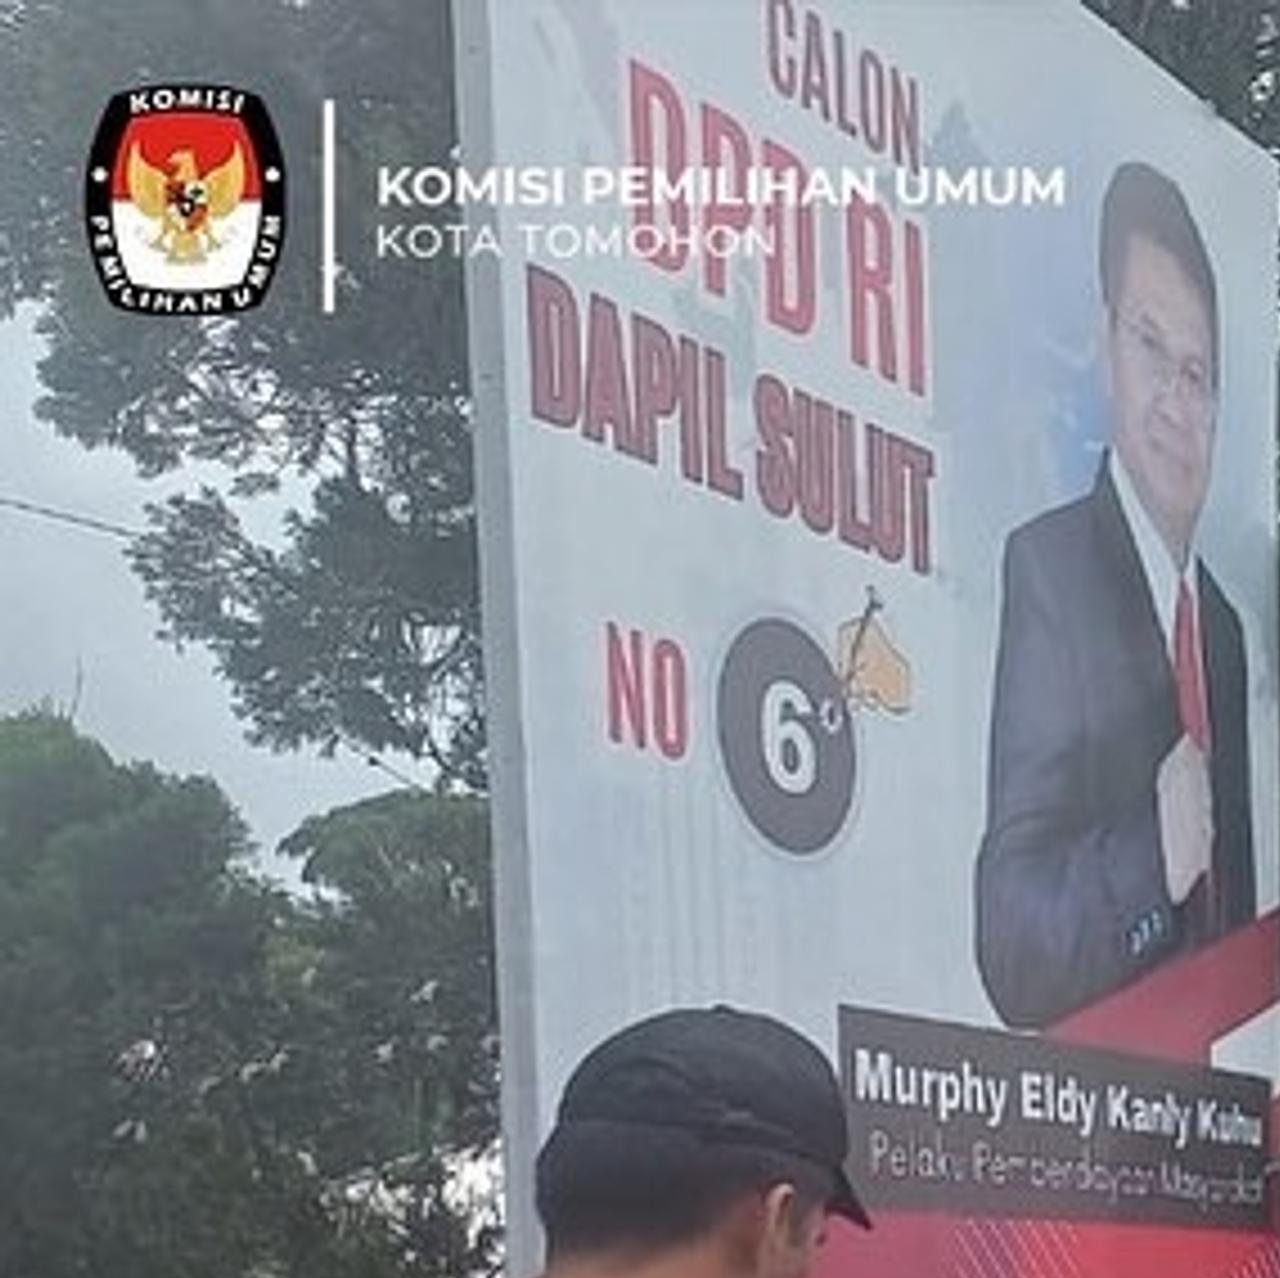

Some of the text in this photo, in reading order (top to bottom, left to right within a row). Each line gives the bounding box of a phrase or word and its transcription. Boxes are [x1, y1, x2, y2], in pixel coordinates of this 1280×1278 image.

[766, 0, 921, 176] CALON
[629, 60, 925, 397] DPD RI
[526, 262, 936, 575] DAPIL SULUT
[606, 620, 818, 796] NO 6
[854, 1048, 1009, 1128] Murphy
[1020, 1072, 1099, 1136] Eldy
[1106, 1085, 1193, 1149] Kanly
